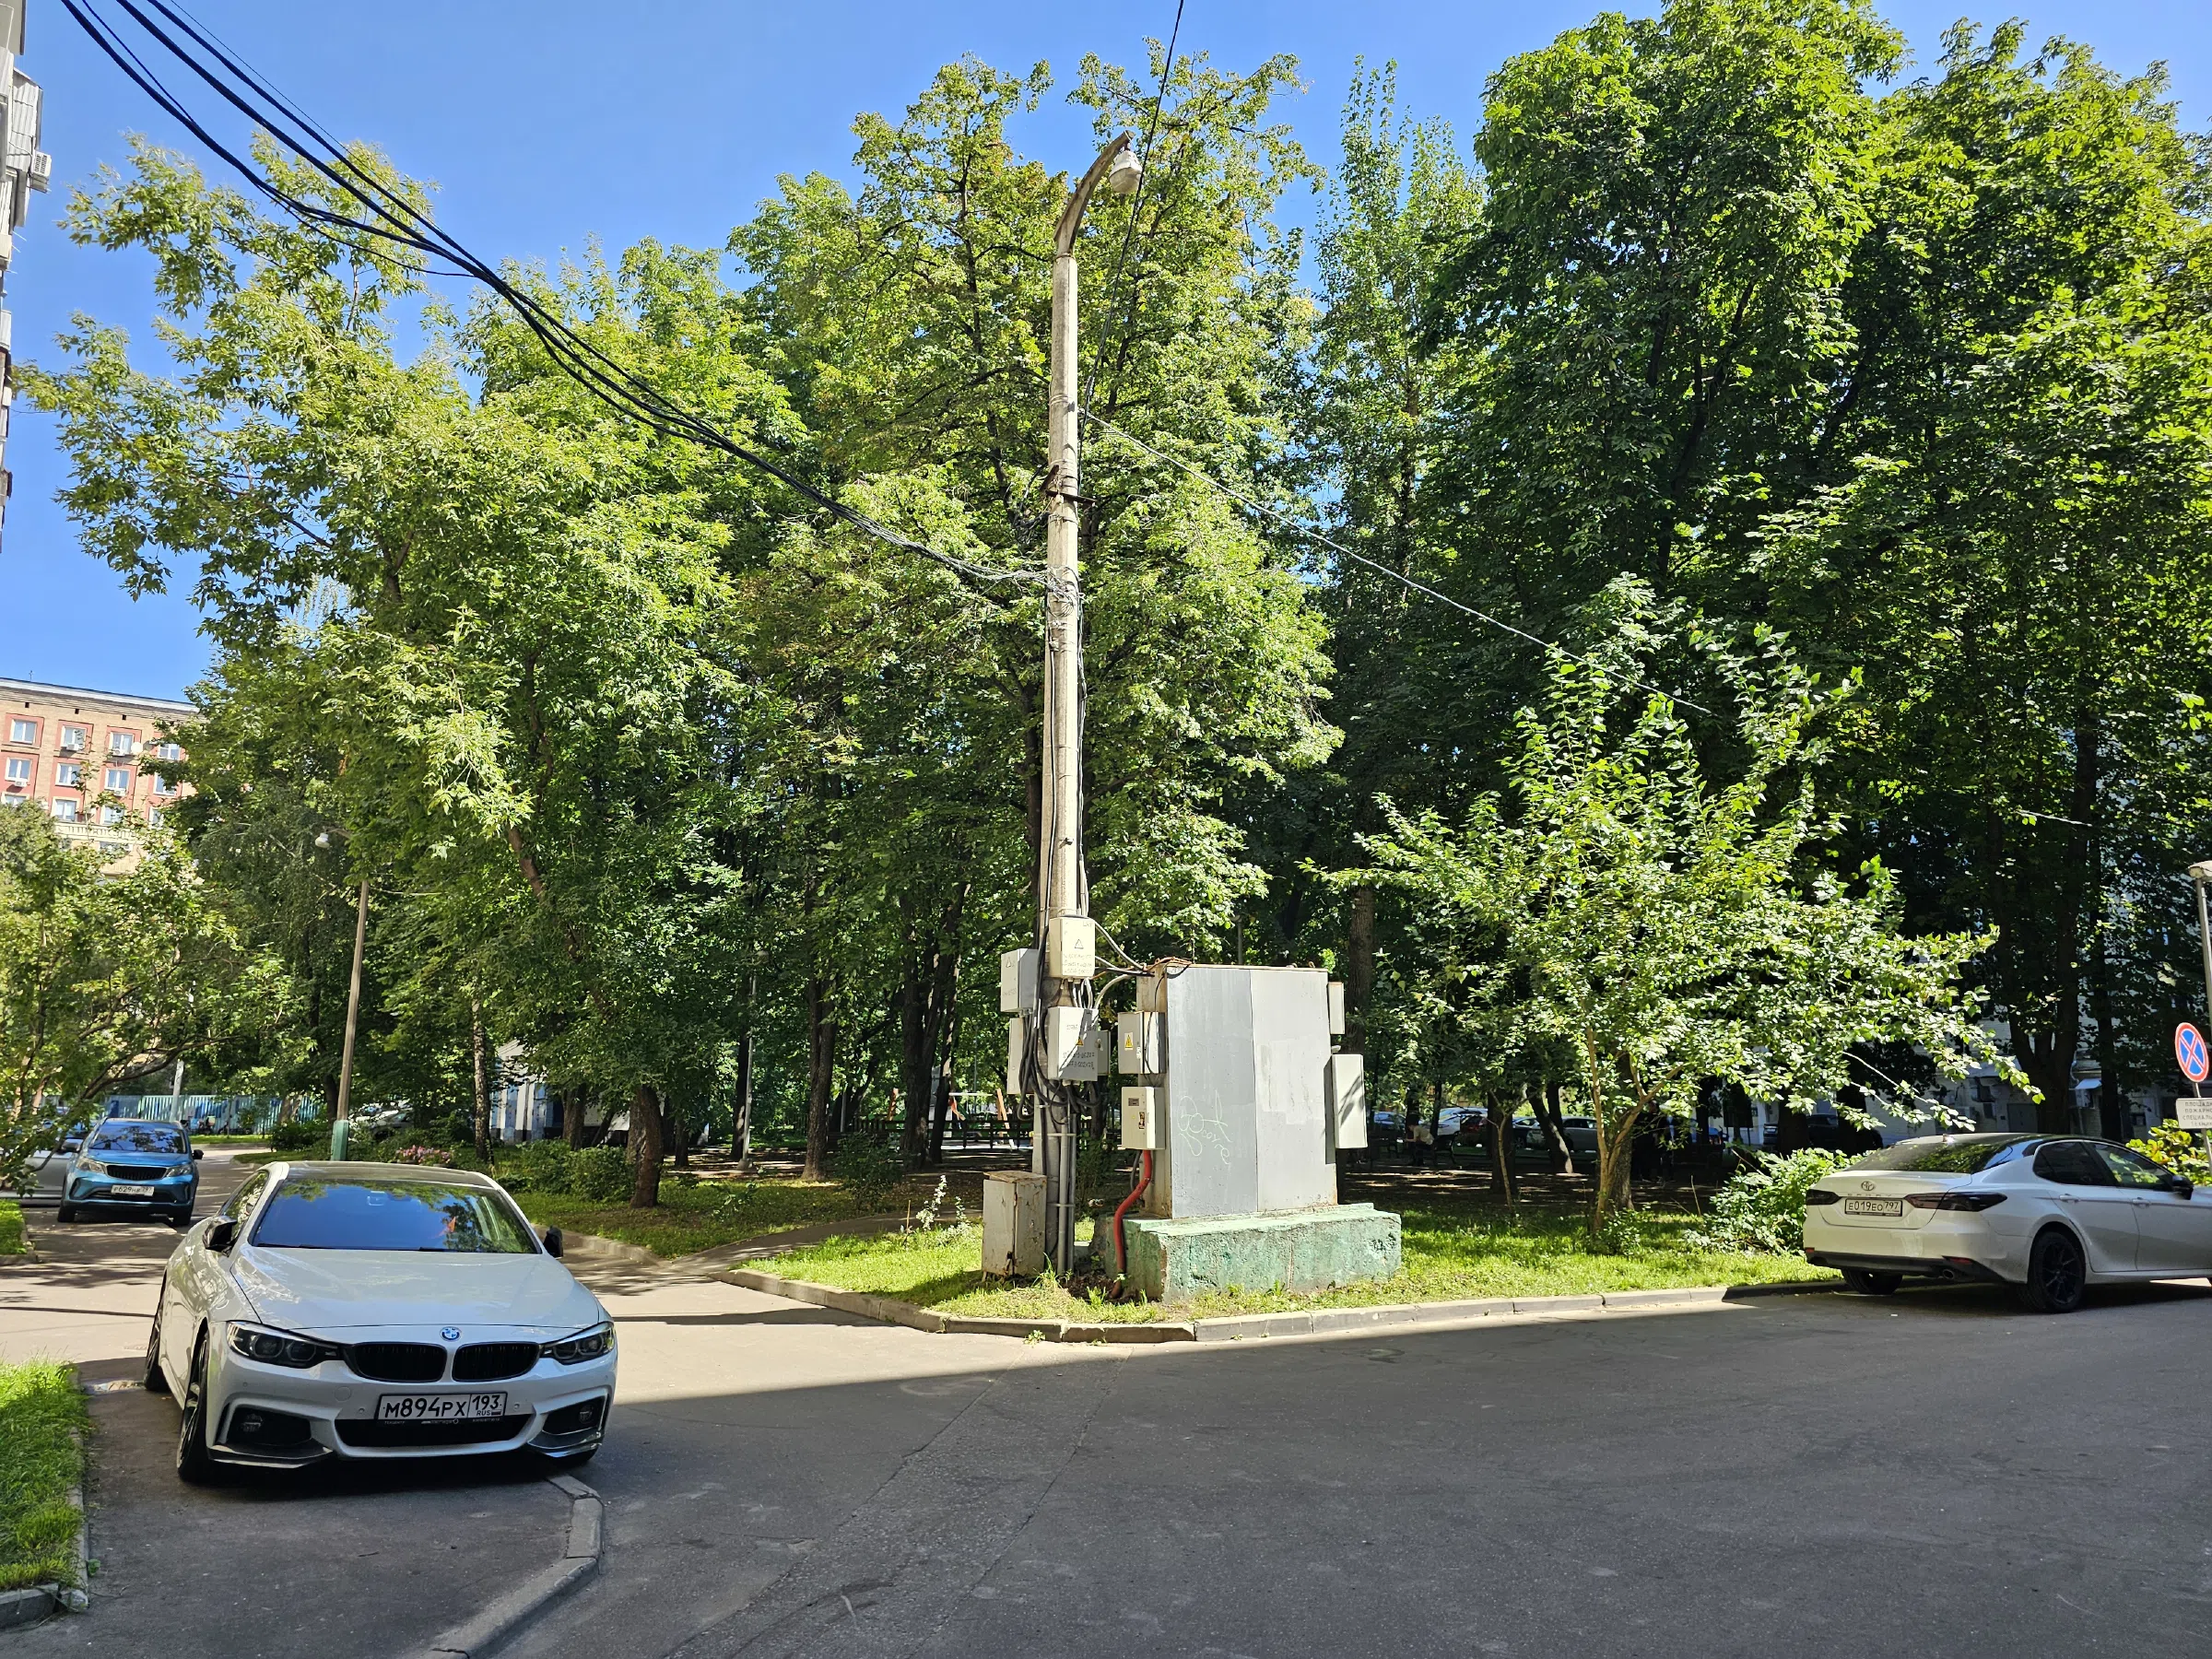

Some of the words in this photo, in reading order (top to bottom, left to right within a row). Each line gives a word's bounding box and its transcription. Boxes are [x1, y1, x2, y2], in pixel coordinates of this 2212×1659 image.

[1885, 1201, 1899, 1209] 797
[384, 1396, 467, 1418] М894РХ
[472, 1394, 500, 1410] 193
